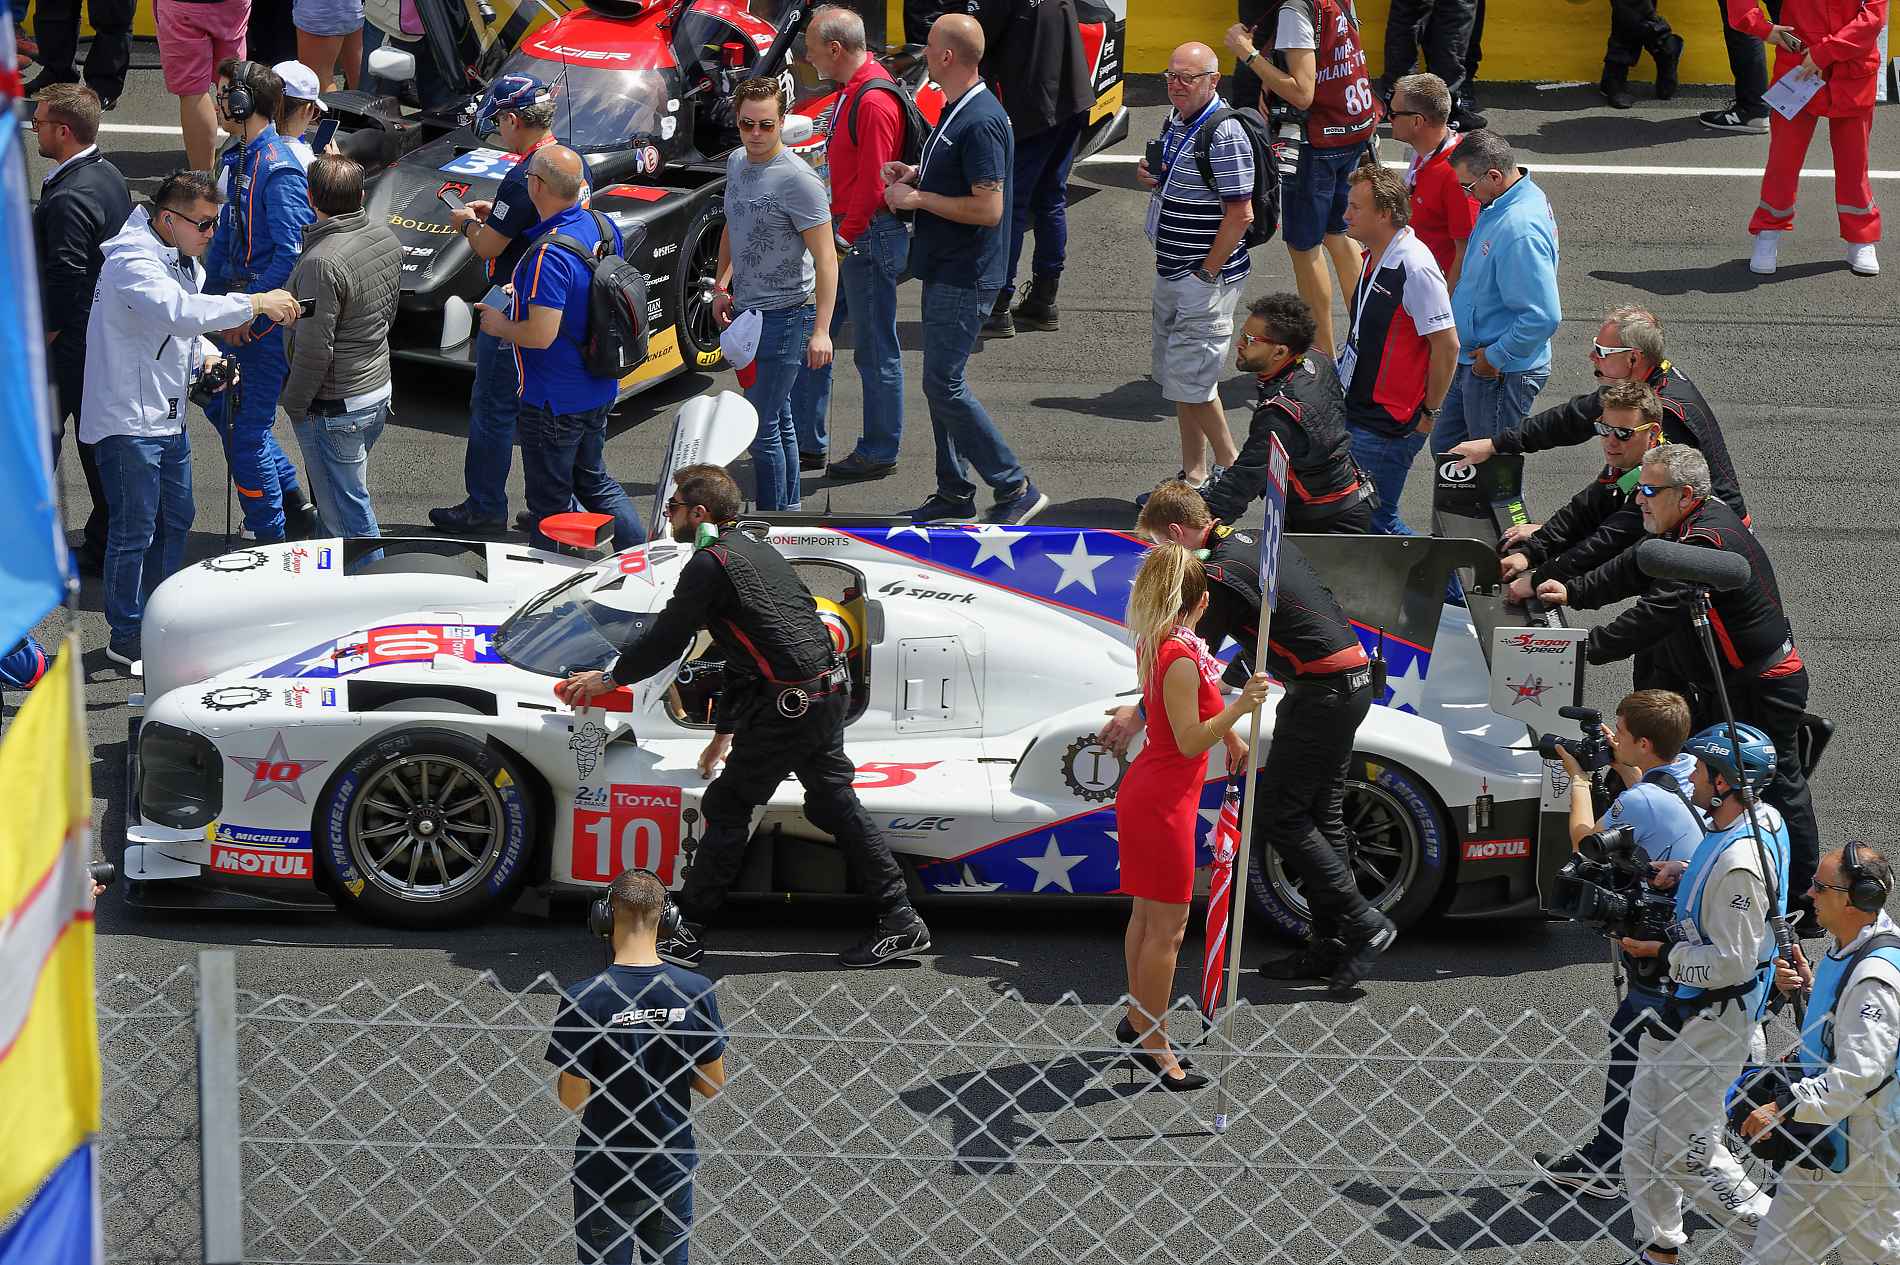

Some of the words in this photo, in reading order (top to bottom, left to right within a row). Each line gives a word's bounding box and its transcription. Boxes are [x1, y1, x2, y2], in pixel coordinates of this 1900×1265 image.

[1345, 77, 1372, 116] 86
[617, 549, 646, 574] 10
[906, 586, 977, 604] spark
[1519, 646, 1567, 654] Speed
[255, 760, 303, 782] 10
[612, 792, 679, 808] TOTAL
[330, 779, 354, 866] MICHELIN
[1393, 779, 1438, 860] MICHELIN
[235, 832, 300, 844] MICHELIN
[495, 802, 524, 887] MICHELIN
[585, 816, 662, 877] 10
[1466, 841, 1527, 858] MOTUL
[215, 850, 308, 876] MOTUL
[612, 1008, 668, 1024] ORECA
